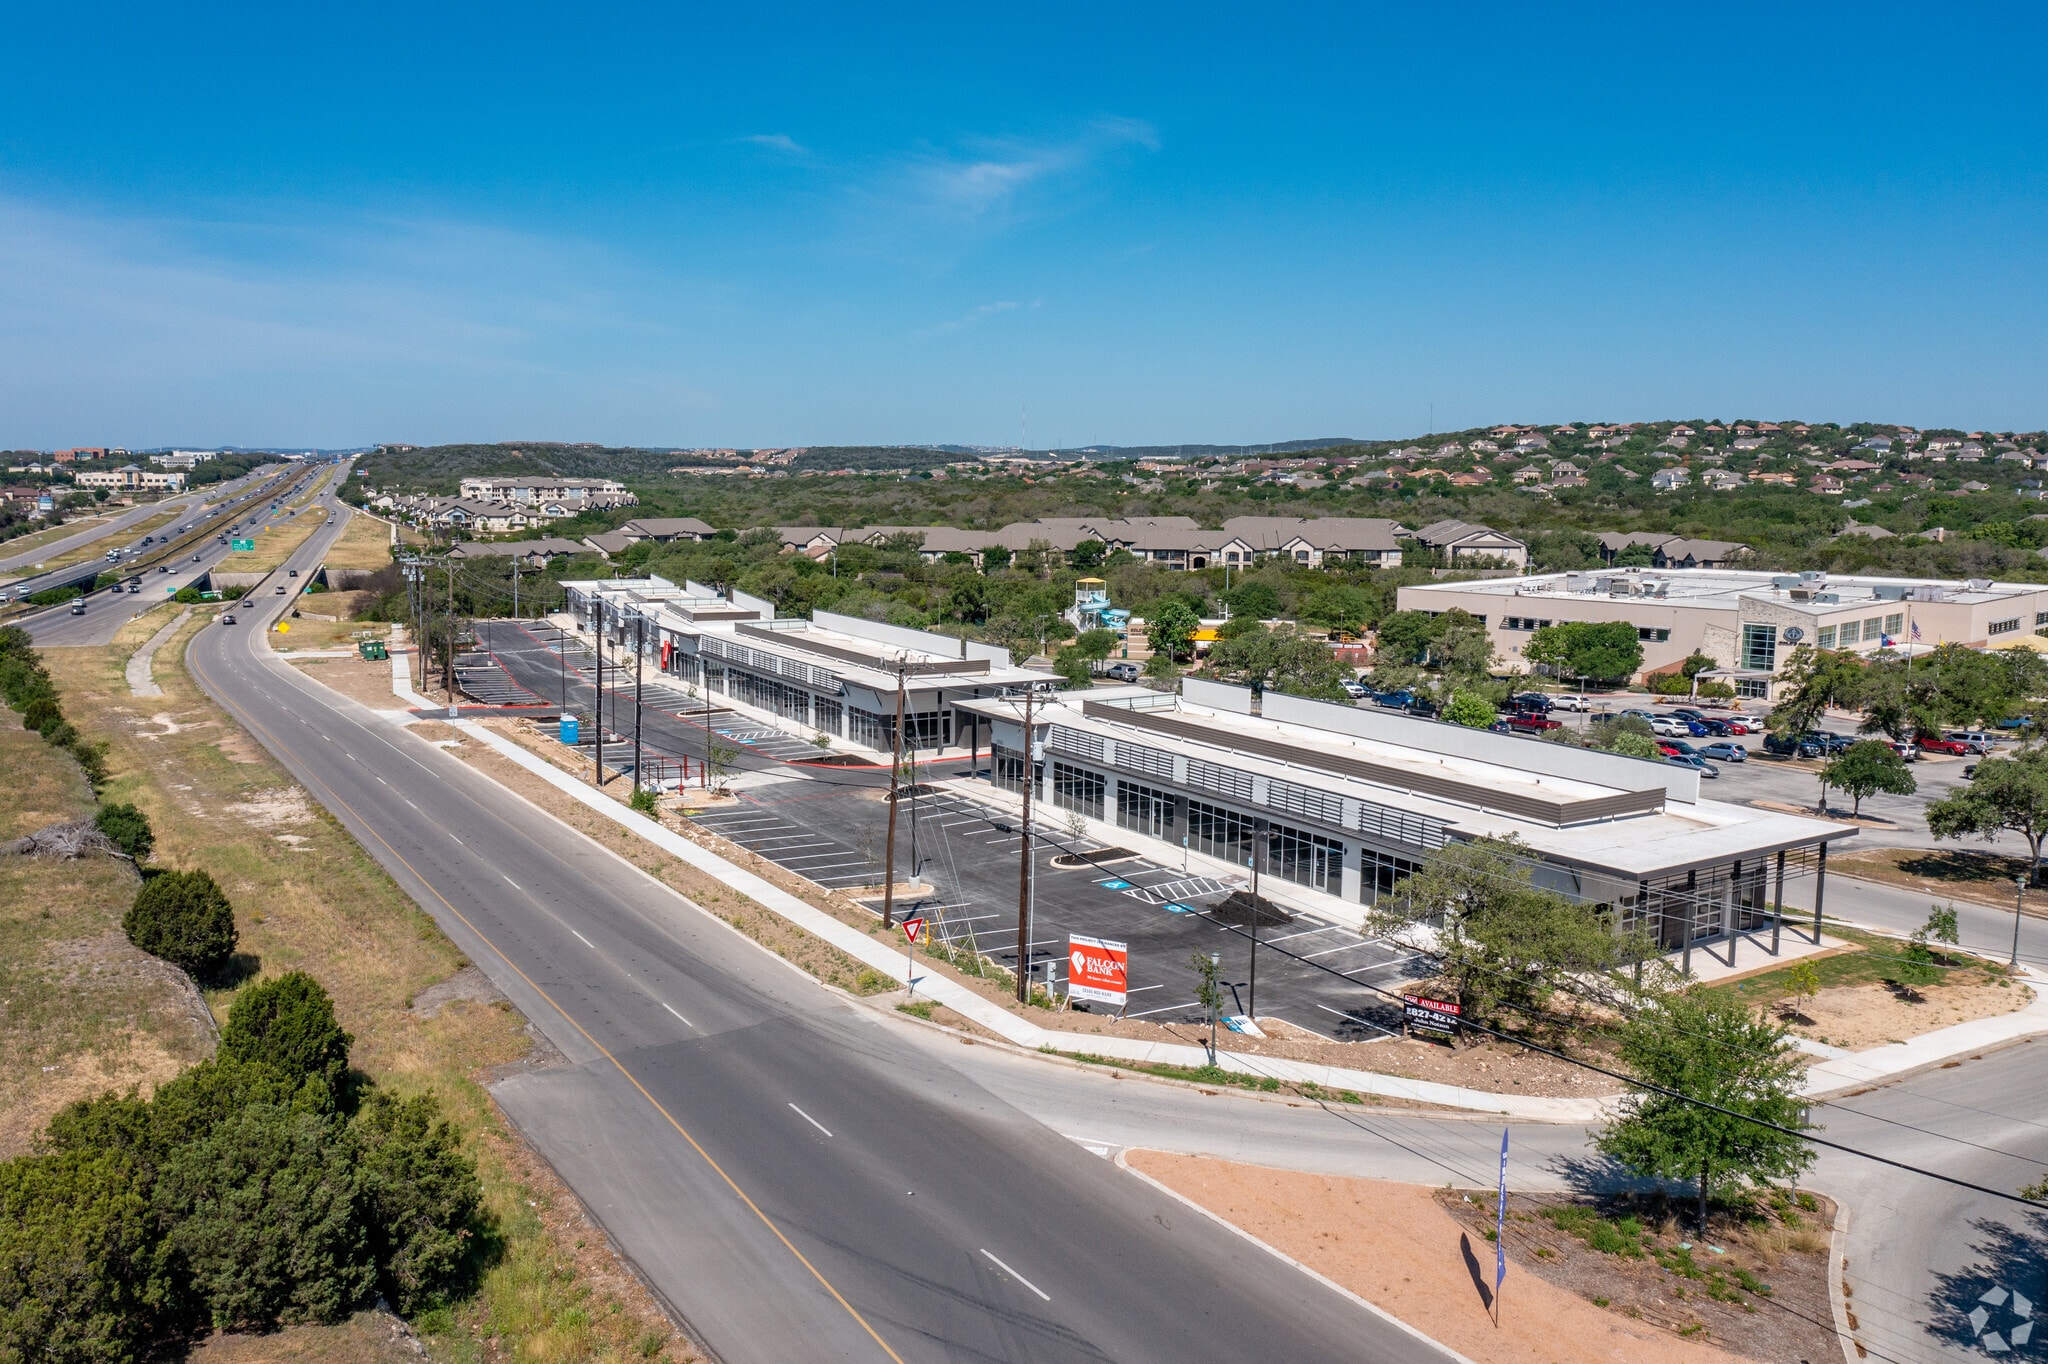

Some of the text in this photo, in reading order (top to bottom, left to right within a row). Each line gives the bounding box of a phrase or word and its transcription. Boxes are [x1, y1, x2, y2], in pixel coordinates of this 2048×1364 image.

[1086, 957, 1125, 971] FALCON
[1087, 965, 1113, 977] BANK
[1421, 1000, 1458, 1013] AVAILABLE
[1414, 1017, 1429, 1025] John
